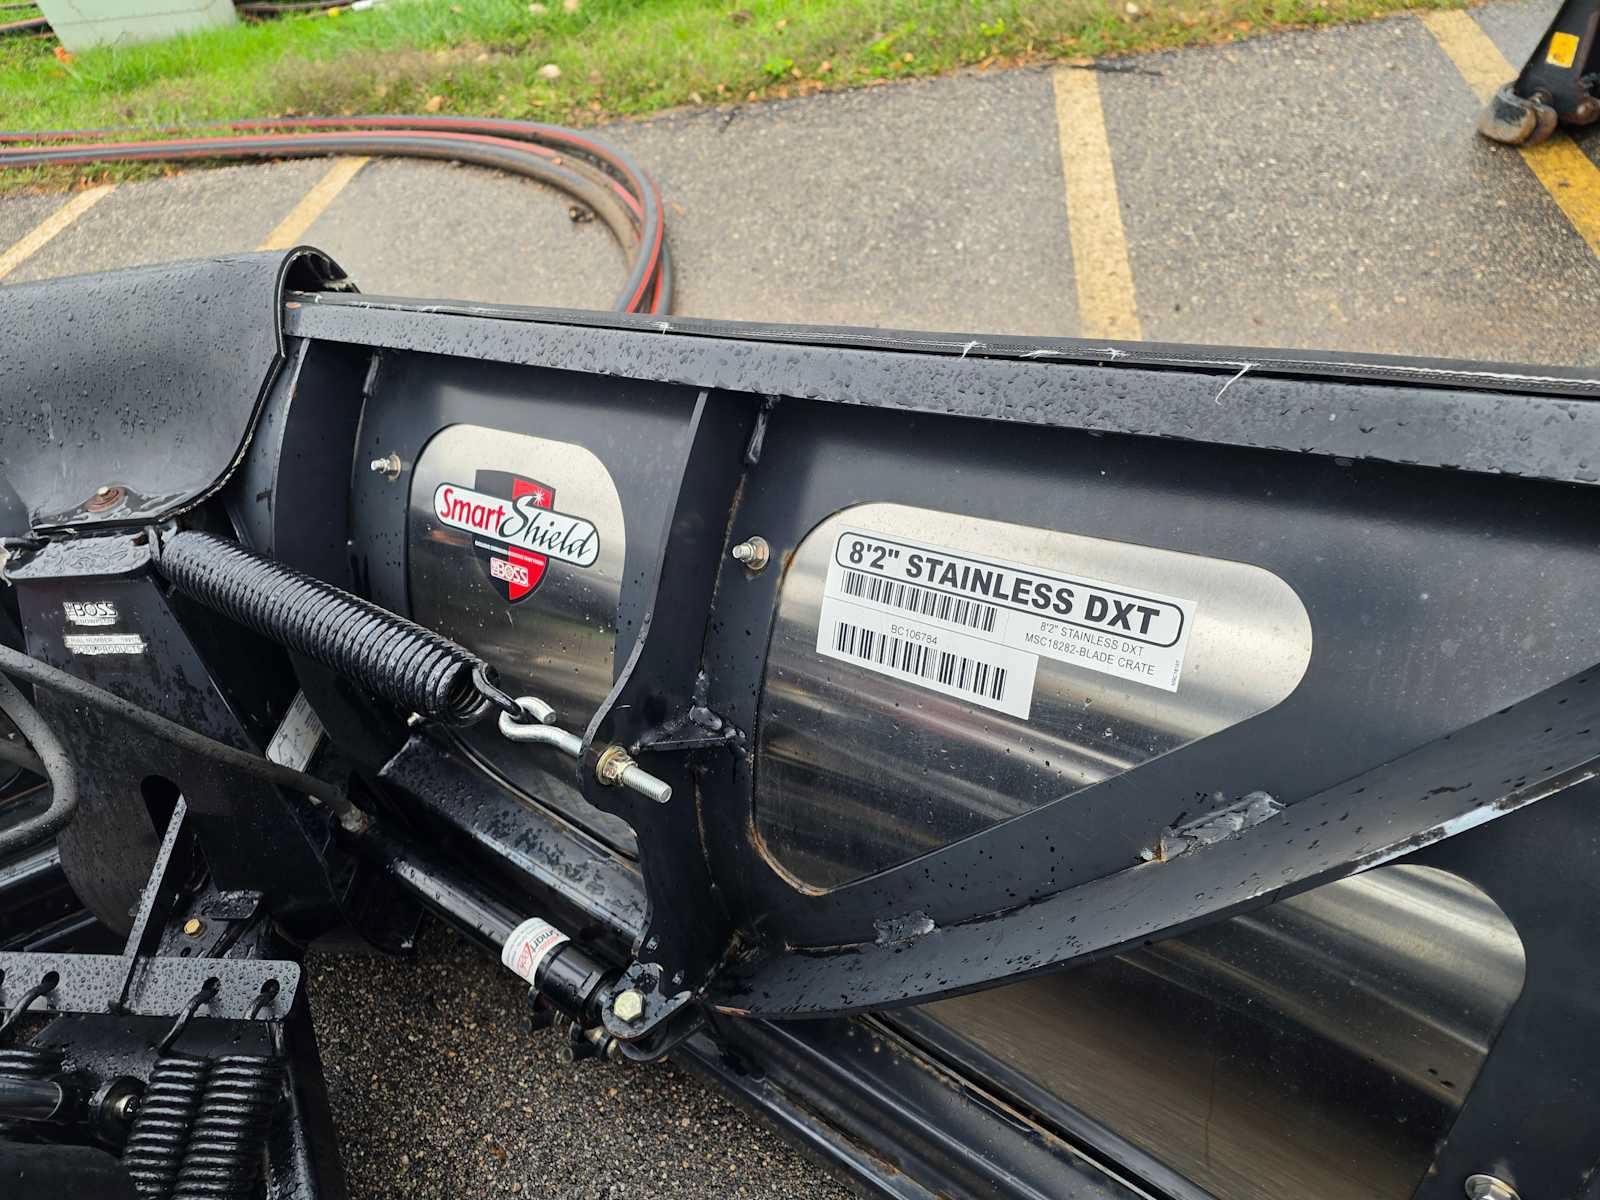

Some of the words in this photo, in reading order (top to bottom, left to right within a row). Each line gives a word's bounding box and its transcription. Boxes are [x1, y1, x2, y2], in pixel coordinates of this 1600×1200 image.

[440, 488, 505, 531] Smart
[500, 494, 598, 560] Shield
[497, 562, 528, 586] BOSS
[848, 540, 900, 571] 8'2"
[905, 553, 1075, 616] STAINLESS
[1083, 594, 1161, 635] DXT
[73, 601, 118, 617] BOSS
[890, 624, 937, 645] BC106784
[1060, 626, 1120, 650] STAINLESS
[1121, 641, 1145, 657] DXT
[1024, 632, 1116, 665] MSC18282-BLADE
[1117, 657, 1156, 676] CRATE
